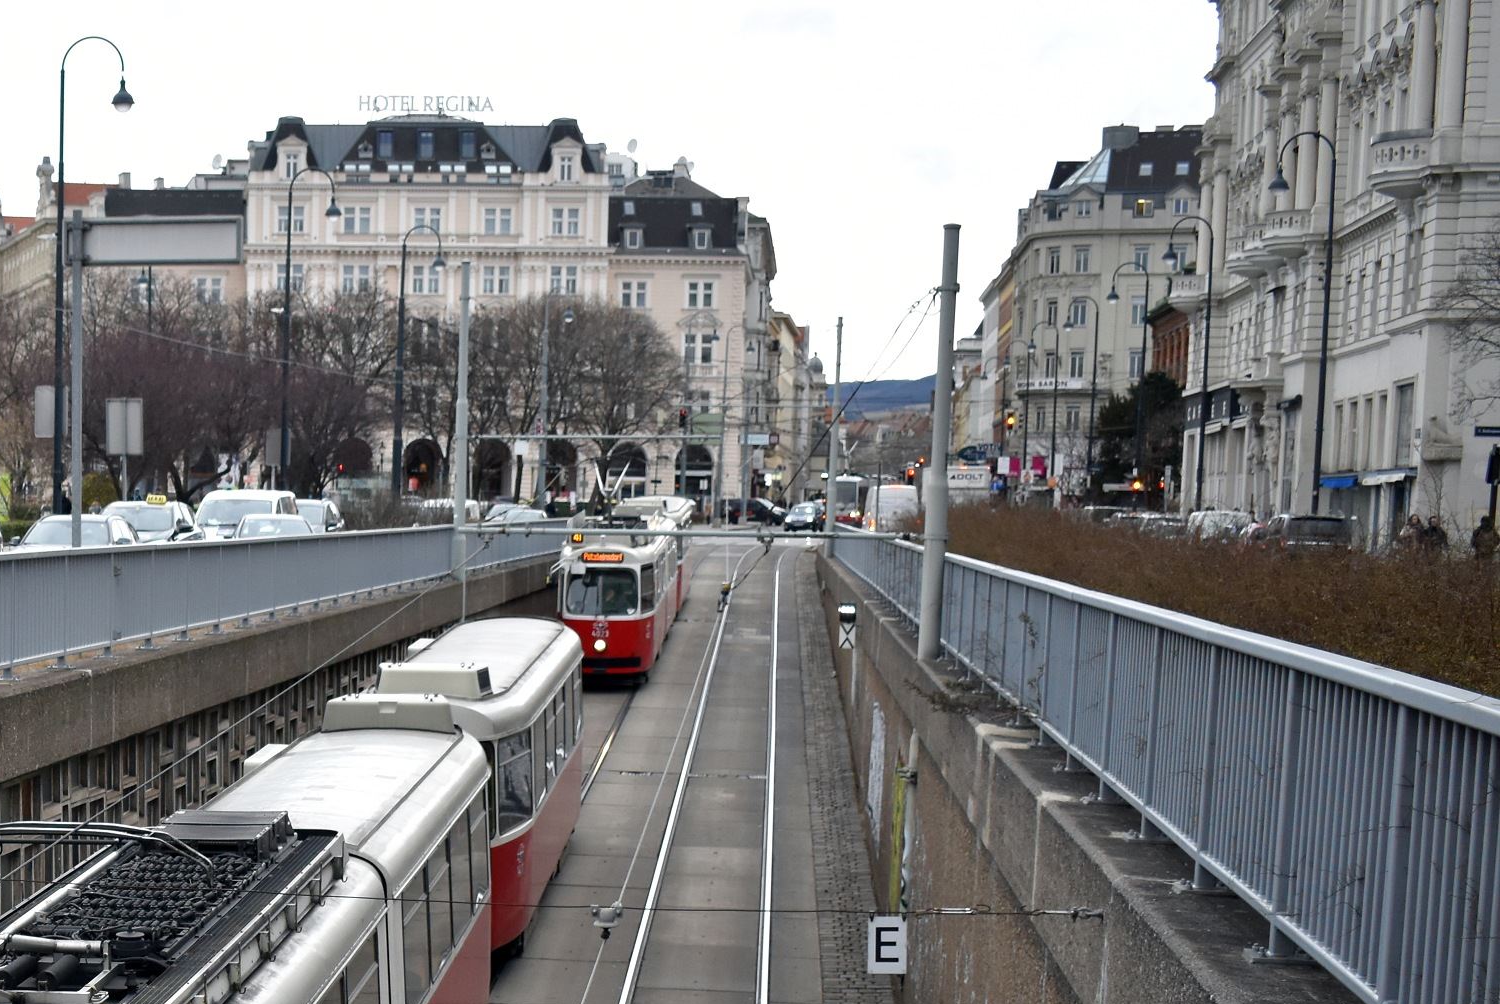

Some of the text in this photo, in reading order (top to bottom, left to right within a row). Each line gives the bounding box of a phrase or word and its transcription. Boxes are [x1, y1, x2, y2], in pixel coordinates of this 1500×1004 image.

[358, 95, 494, 112] HOTEL REGINA
[875, 926, 899, 963] E
